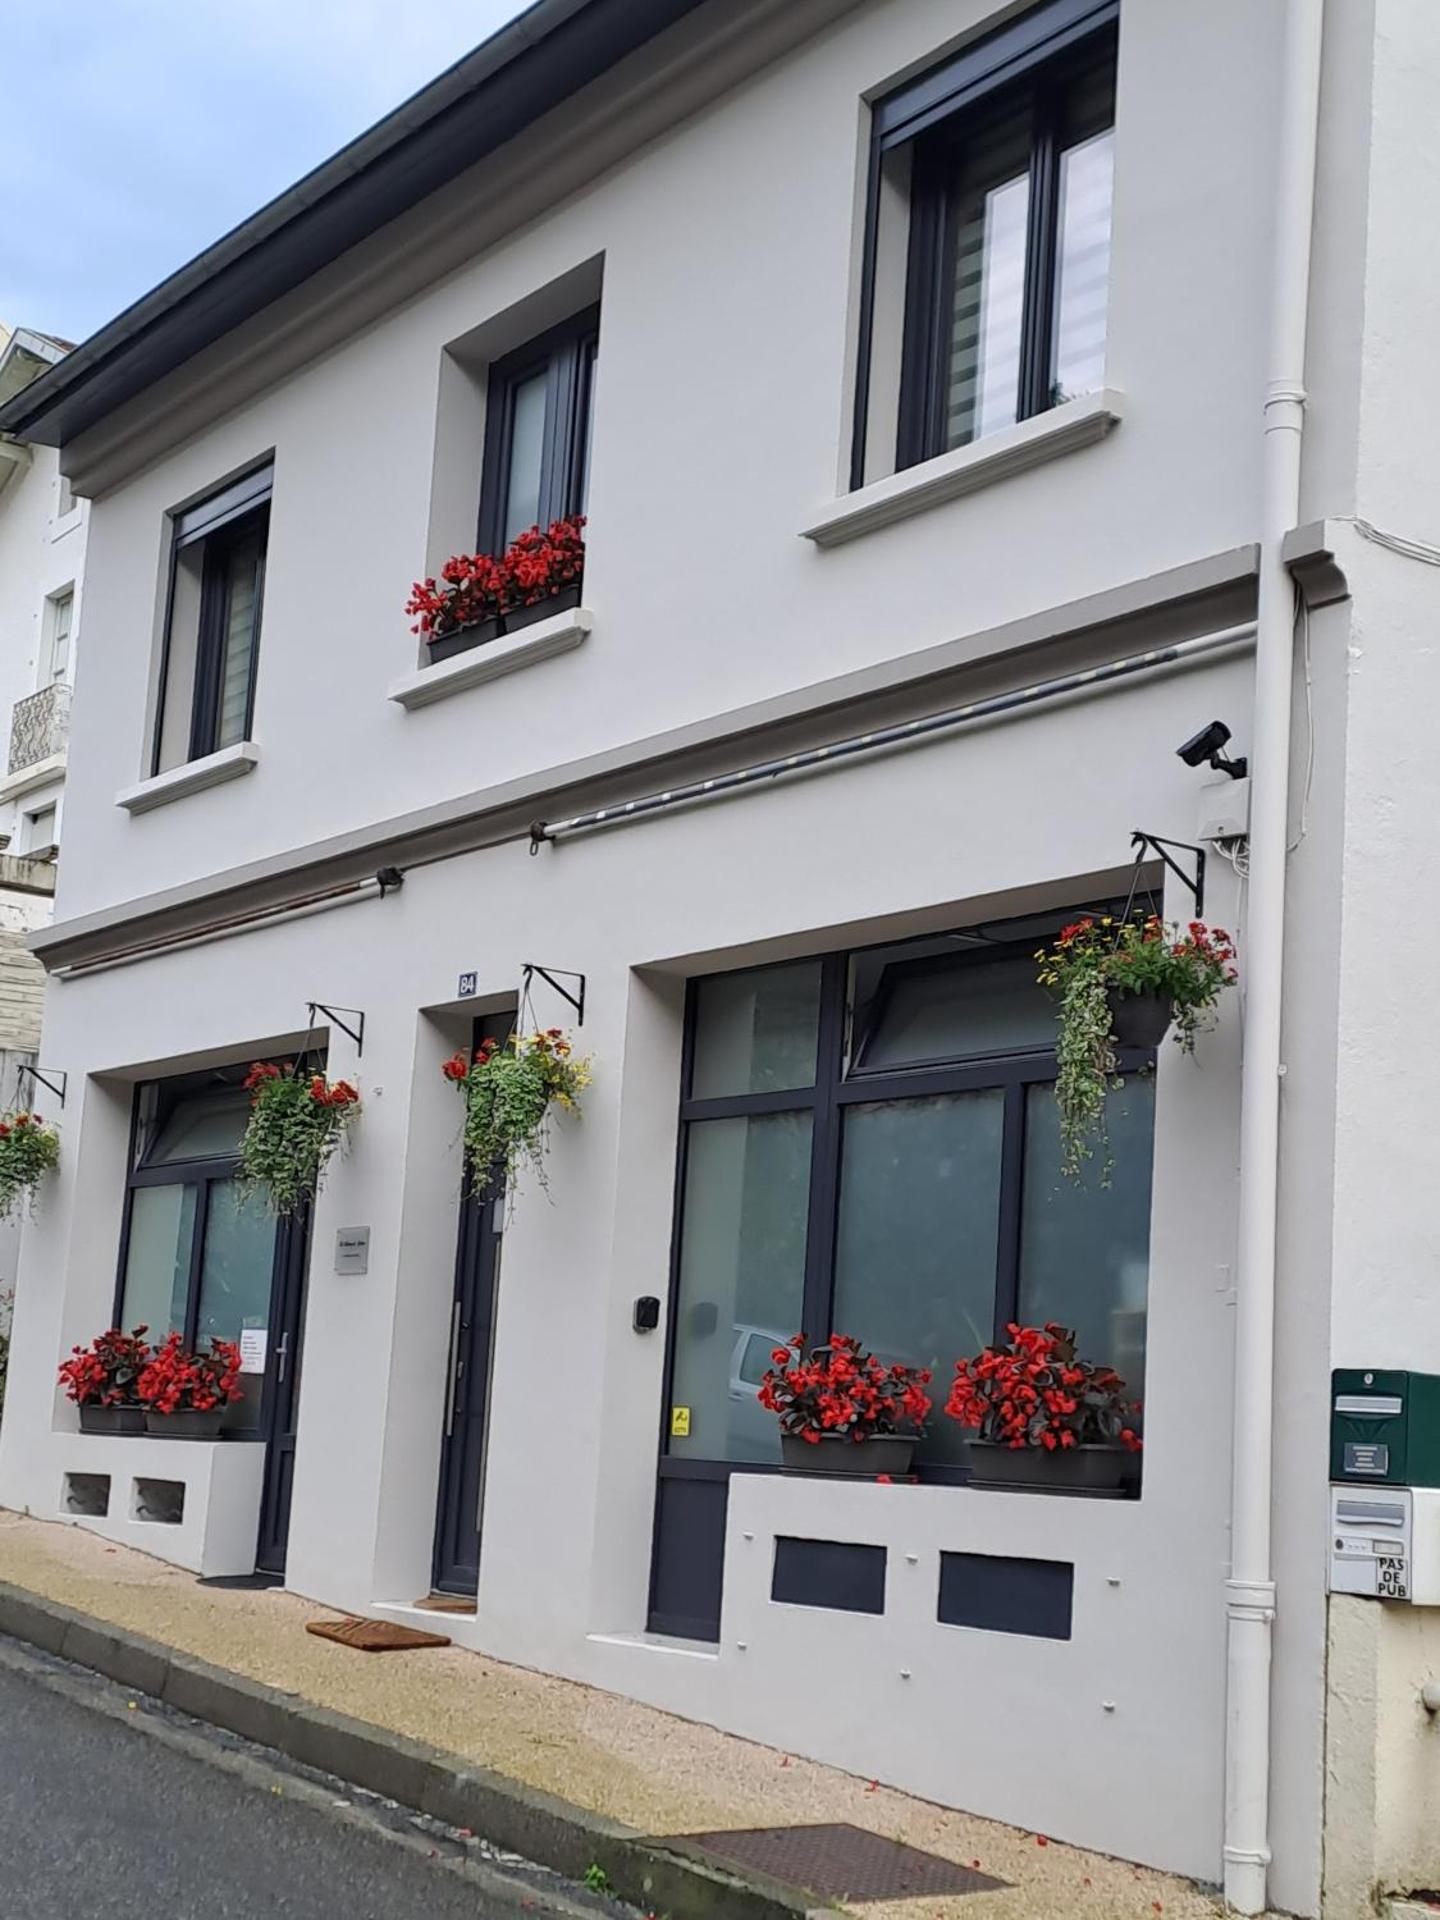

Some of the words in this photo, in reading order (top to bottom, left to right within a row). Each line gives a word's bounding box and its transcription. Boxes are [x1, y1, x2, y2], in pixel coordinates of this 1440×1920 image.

[460, 976, 474, 993] 84
[1379, 1557, 1404, 1571] PAS
[1383, 1571, 1401, 1584] DE
[1378, 1583, 1406, 1597] PUB
